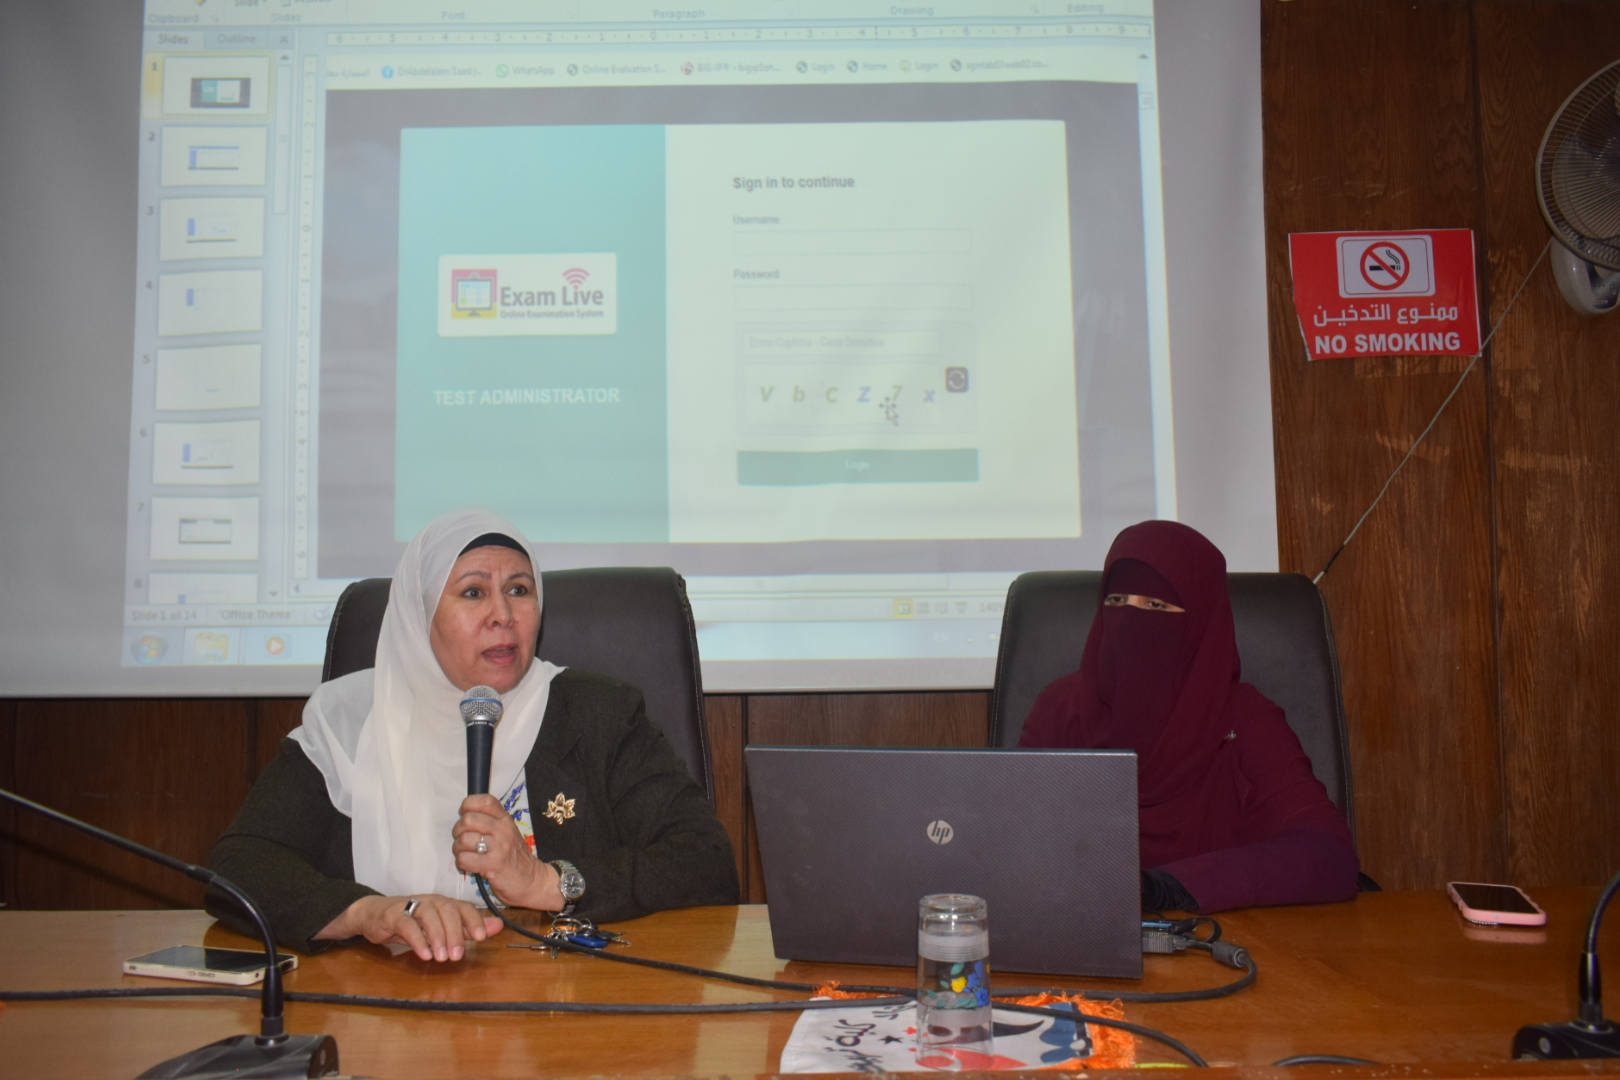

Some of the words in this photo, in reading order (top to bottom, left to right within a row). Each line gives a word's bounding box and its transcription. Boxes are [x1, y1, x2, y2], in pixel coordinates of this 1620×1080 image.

[653, 8, 705, 20] Paragraph
[890, 6, 935, 17] Drawing
[1067, 4, 1104, 14] Editing
[149, 14, 200, 24] Clipboard
[441, 11, 466, 20] Font
[158, 34, 189, 45] Slides
[217, 33, 257, 44] Outline
[513, 65, 555, 76] WhatsApp
[582, 64, 609, 74] Online
[611, 64, 653, 74] Evaluation
[812, 62, 836, 73] Login
[863, 62, 888, 71] Home
[915, 61, 939, 71] Login
[733, 176, 762, 192] Sign
[766, 176, 778, 188] in
[781, 177, 795, 188] to
[798, 175, 855, 188] continue
[733, 215, 780, 225] Username
[734, 269, 780, 279] Password
[500, 286, 556, 306] Exam
[562, 284, 604, 306] Live
[500, 310, 526, 319] Online
[527, 309, 575, 319] Examination
[576, 309, 604, 320] System
[1313, 303, 1391, 327] التدخين
[1397, 303, 1458, 325] ممنوع
[1315, 335, 1347, 354] NO
[1355, 332, 1461, 352] SMOKING
[433, 389, 477, 405] TEST
[480, 388, 621, 405] ADMINISTRATOR
[792, 384, 806, 402] b
[132, 610, 158, 621] Slide
[170, 610, 182, 620] of
[184, 610, 197, 620] 14
[929, 820, 951, 845] hp
